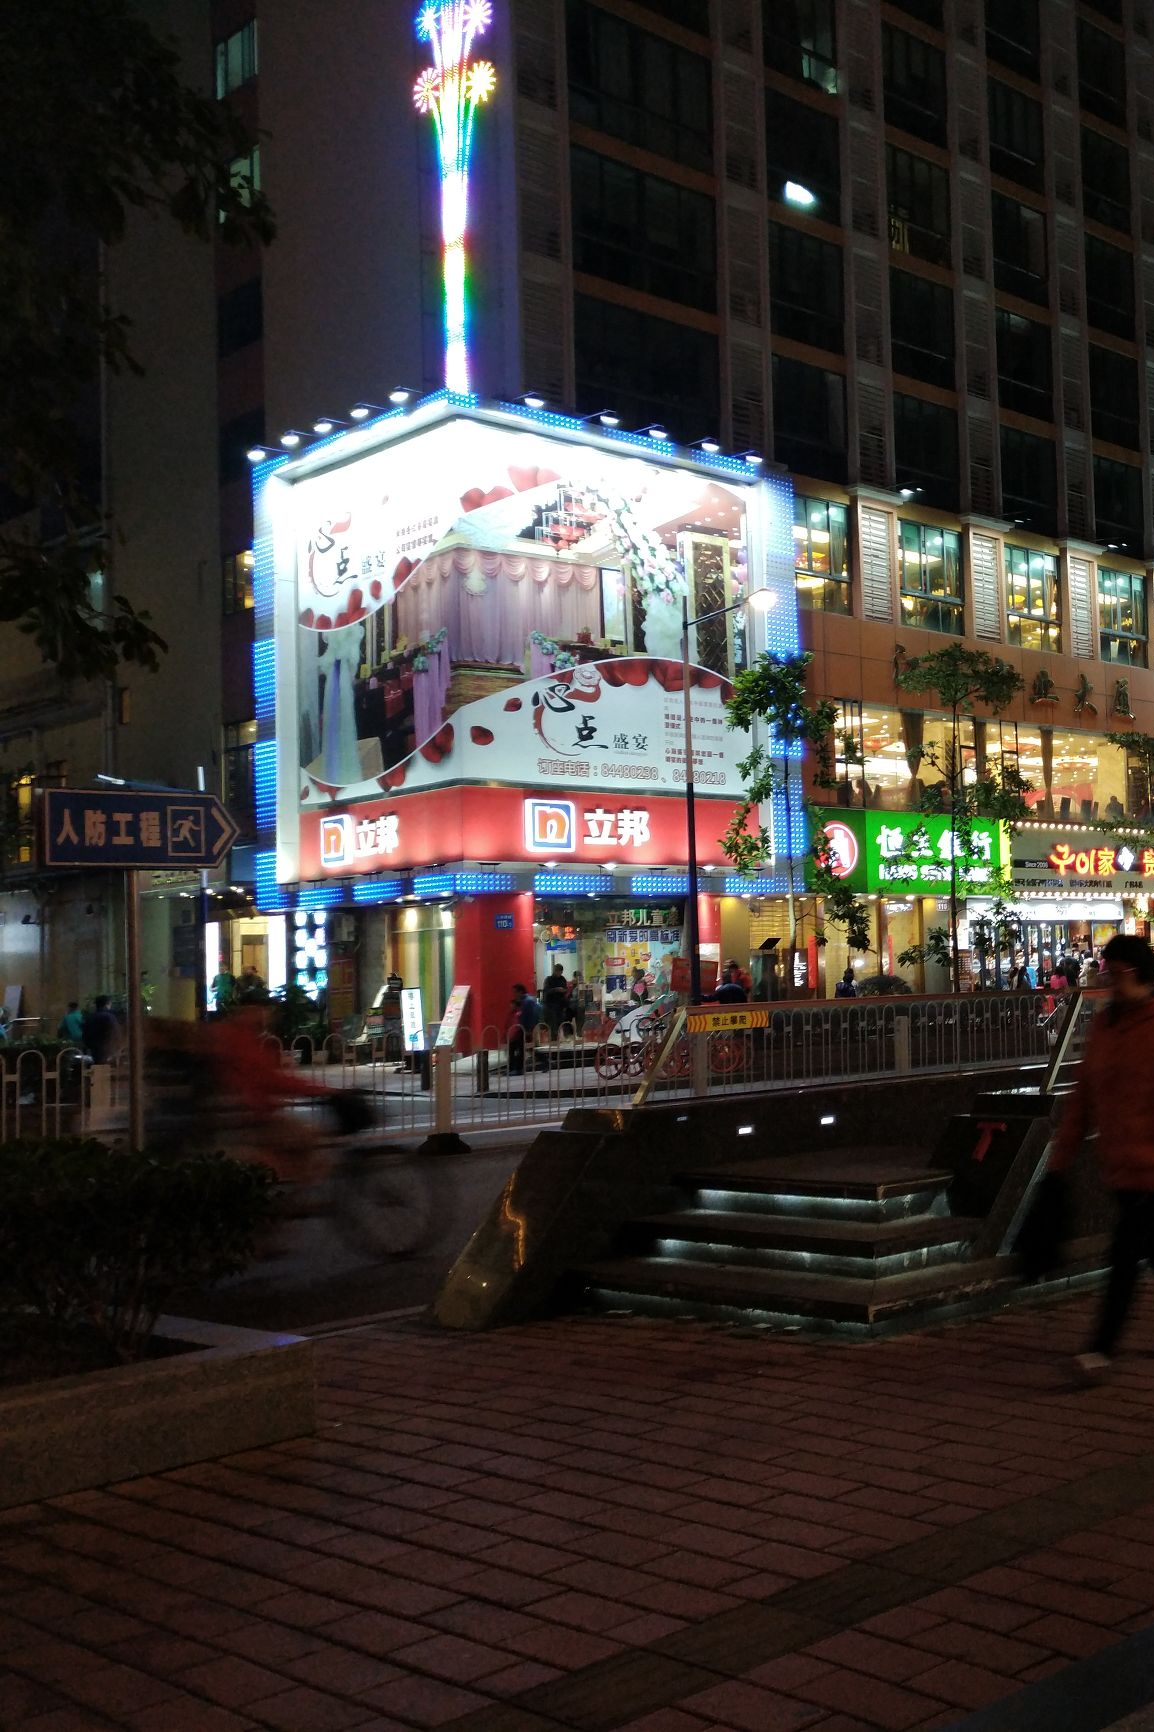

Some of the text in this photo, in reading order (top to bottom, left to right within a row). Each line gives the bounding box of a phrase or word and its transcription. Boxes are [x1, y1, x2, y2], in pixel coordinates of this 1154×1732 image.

[612, 733, 649, 751] 盛宴
[56, 808, 162, 847] 人防工程
[353, 814, 400, 857] 立邦
[583, 809, 651, 848] 立邦
